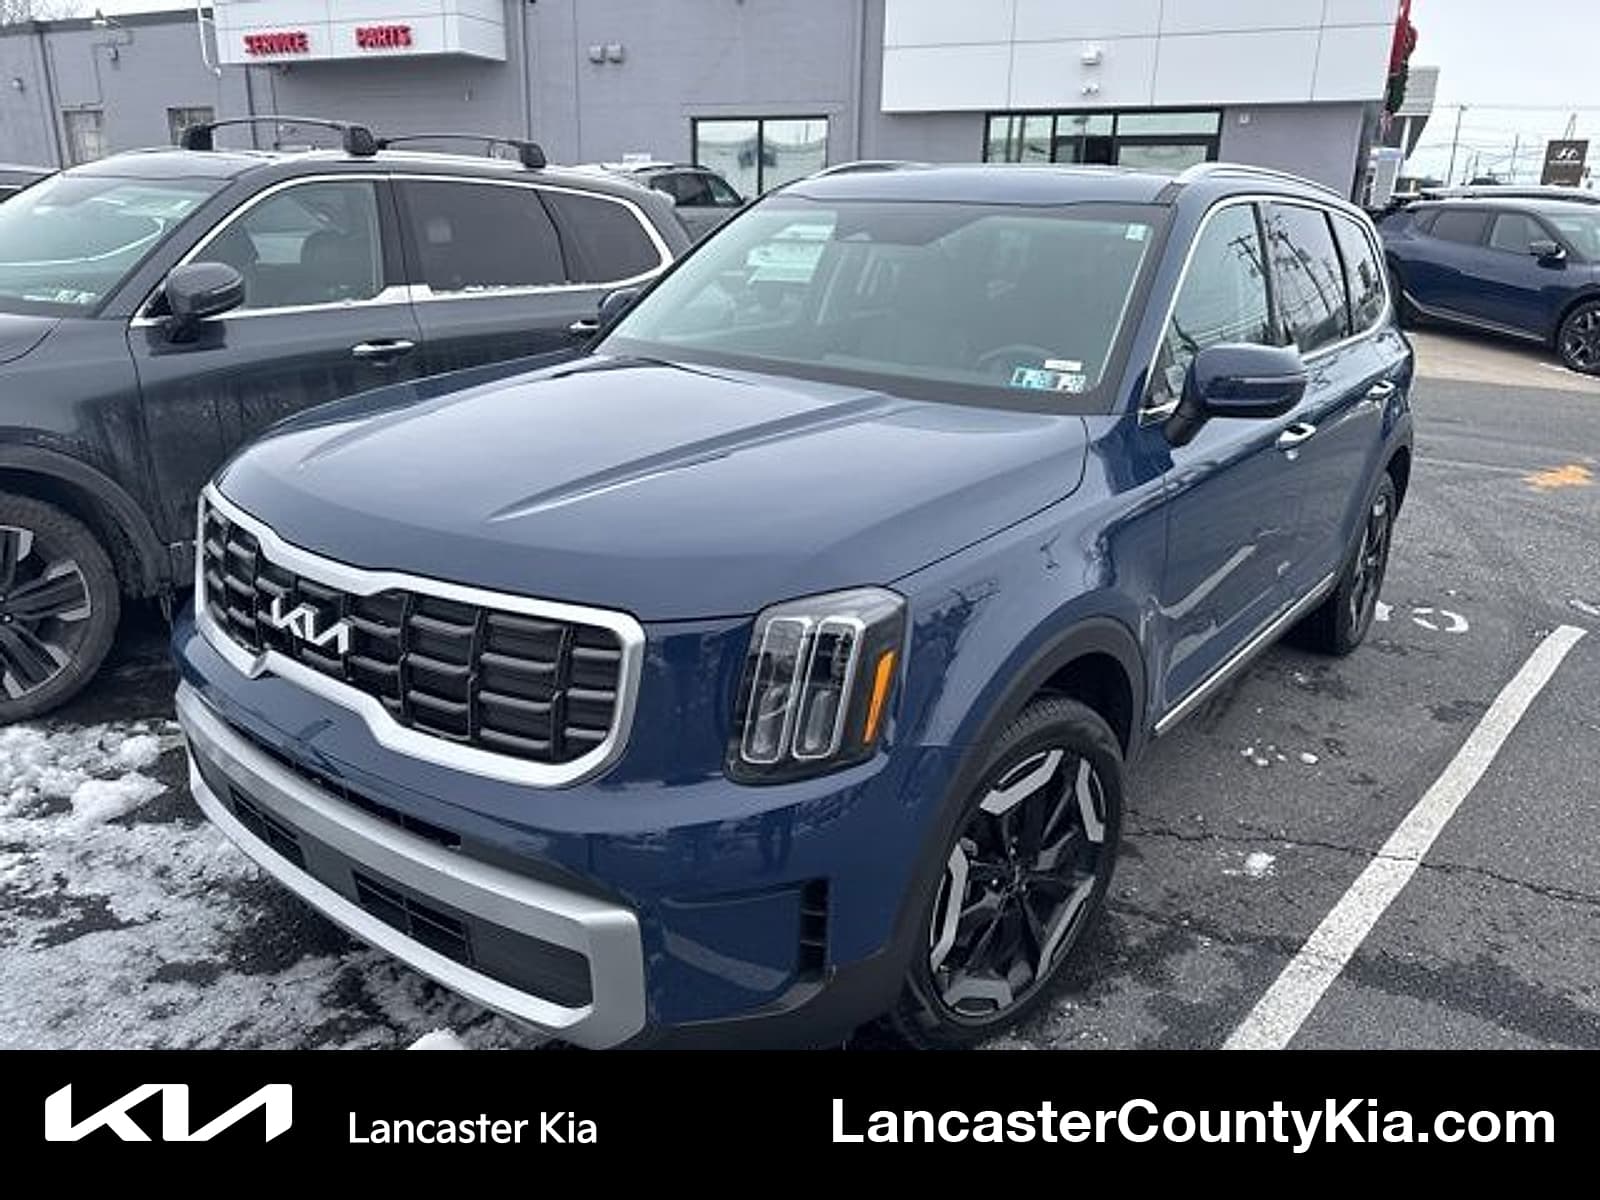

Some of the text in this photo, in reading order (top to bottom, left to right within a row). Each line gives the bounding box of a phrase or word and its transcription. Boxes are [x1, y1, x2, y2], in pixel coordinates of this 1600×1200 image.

[244, 31, 308, 55] SERVICE
[355, 25, 411, 48] PARTS
[270, 595, 351, 655] KIA
